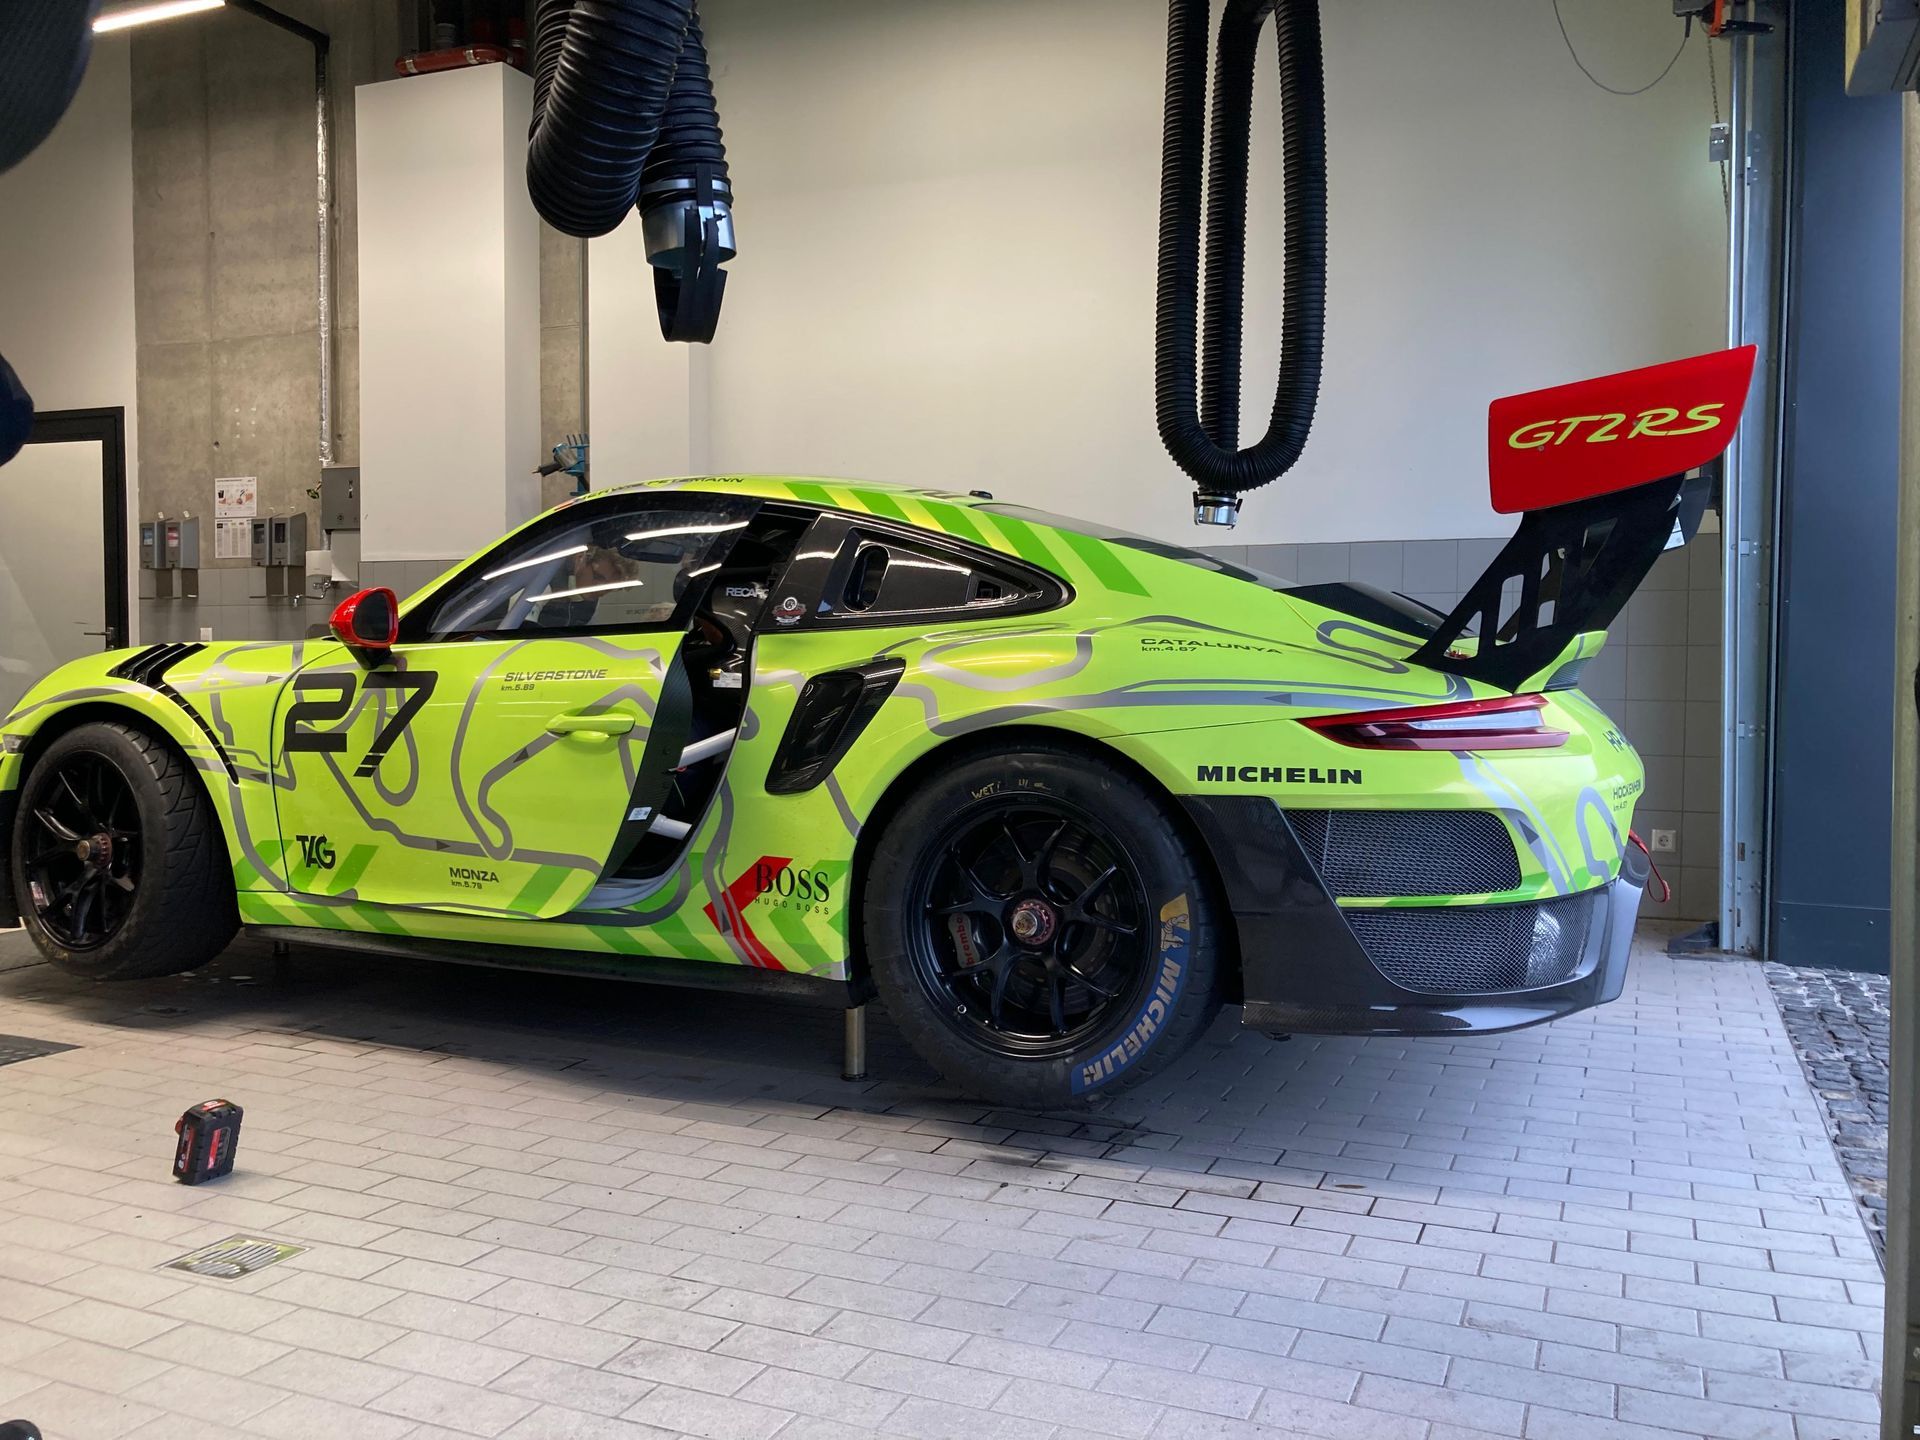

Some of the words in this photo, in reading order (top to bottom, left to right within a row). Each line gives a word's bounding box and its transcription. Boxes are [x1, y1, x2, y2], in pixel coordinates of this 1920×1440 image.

[1141, 638, 1283, 654] CATALUNYA
[504, 669, 608, 682] SILVERSTONE
[284, 670, 439, 778] 27
[1197, 765, 1362, 785] MICHELIN
[296, 834, 336, 870] TAG
[449, 867, 500, 883] MONZA
[755, 863, 830, 903] BOSS
[754, 897, 788, 909] HUGO
[796, 902, 829, 915] BOSS
[1083, 957, 1181, 1086] MICHELIN
